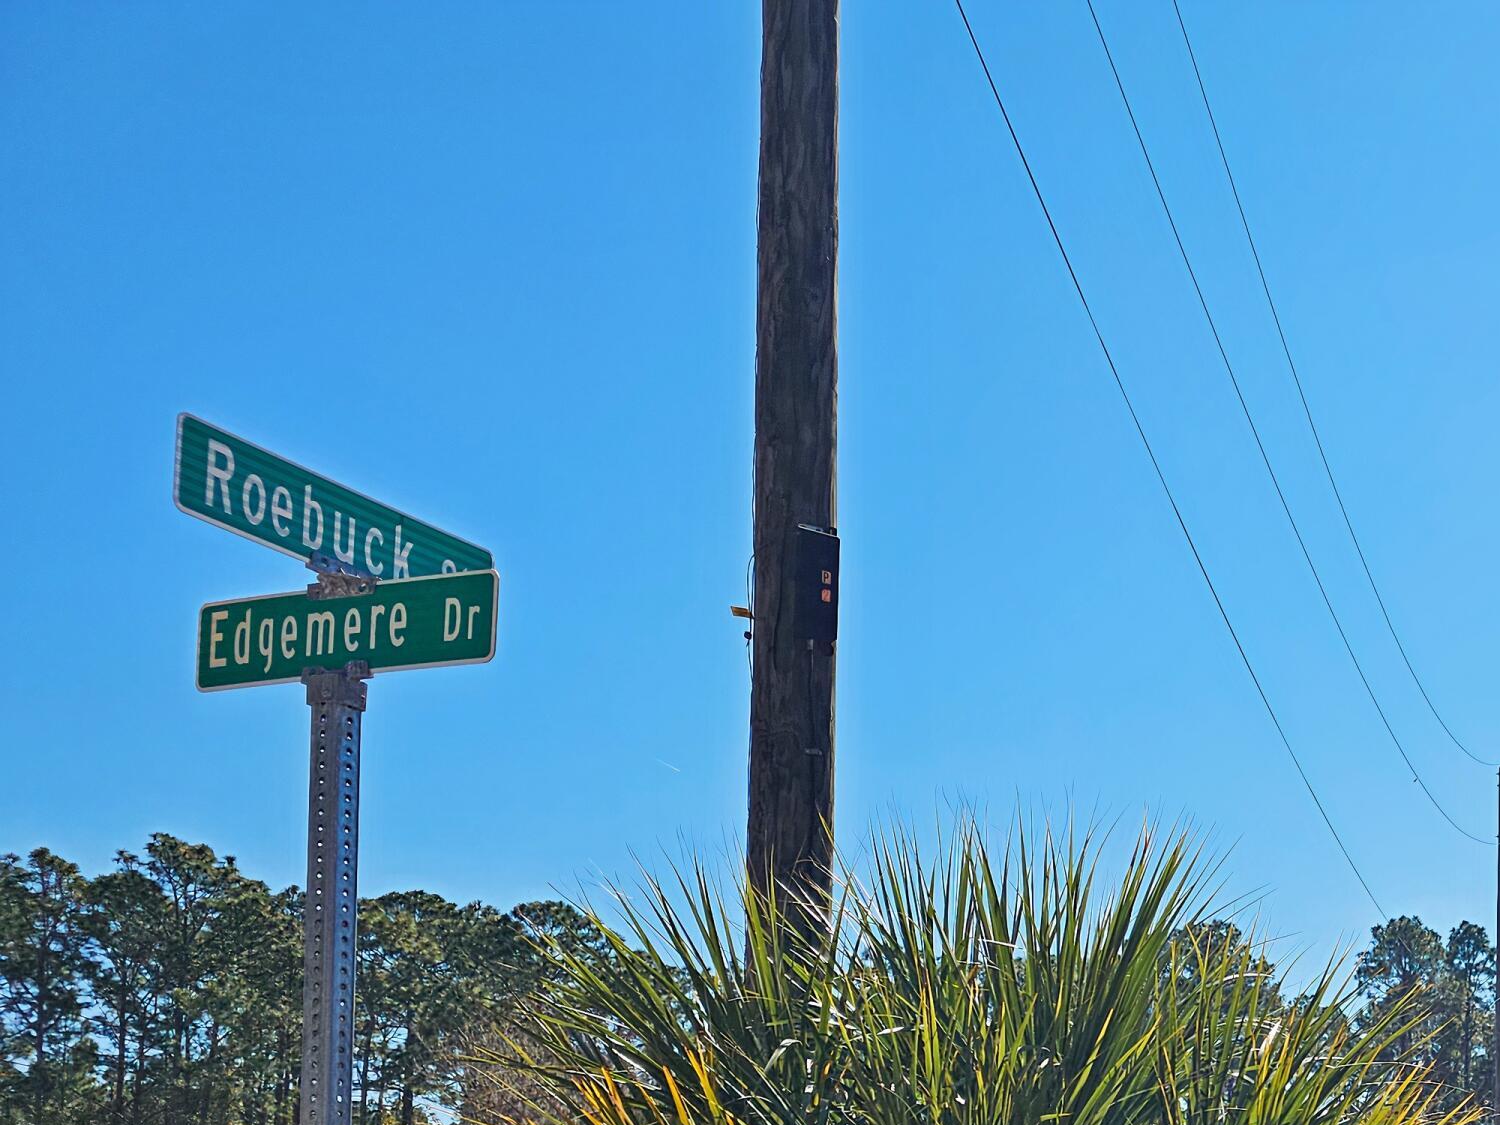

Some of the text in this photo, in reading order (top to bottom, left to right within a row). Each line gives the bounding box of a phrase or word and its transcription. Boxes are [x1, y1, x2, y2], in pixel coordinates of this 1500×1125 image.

[205, 438, 414, 580] Roebuck
[209, 597, 480, 673] Edgemere Dr
